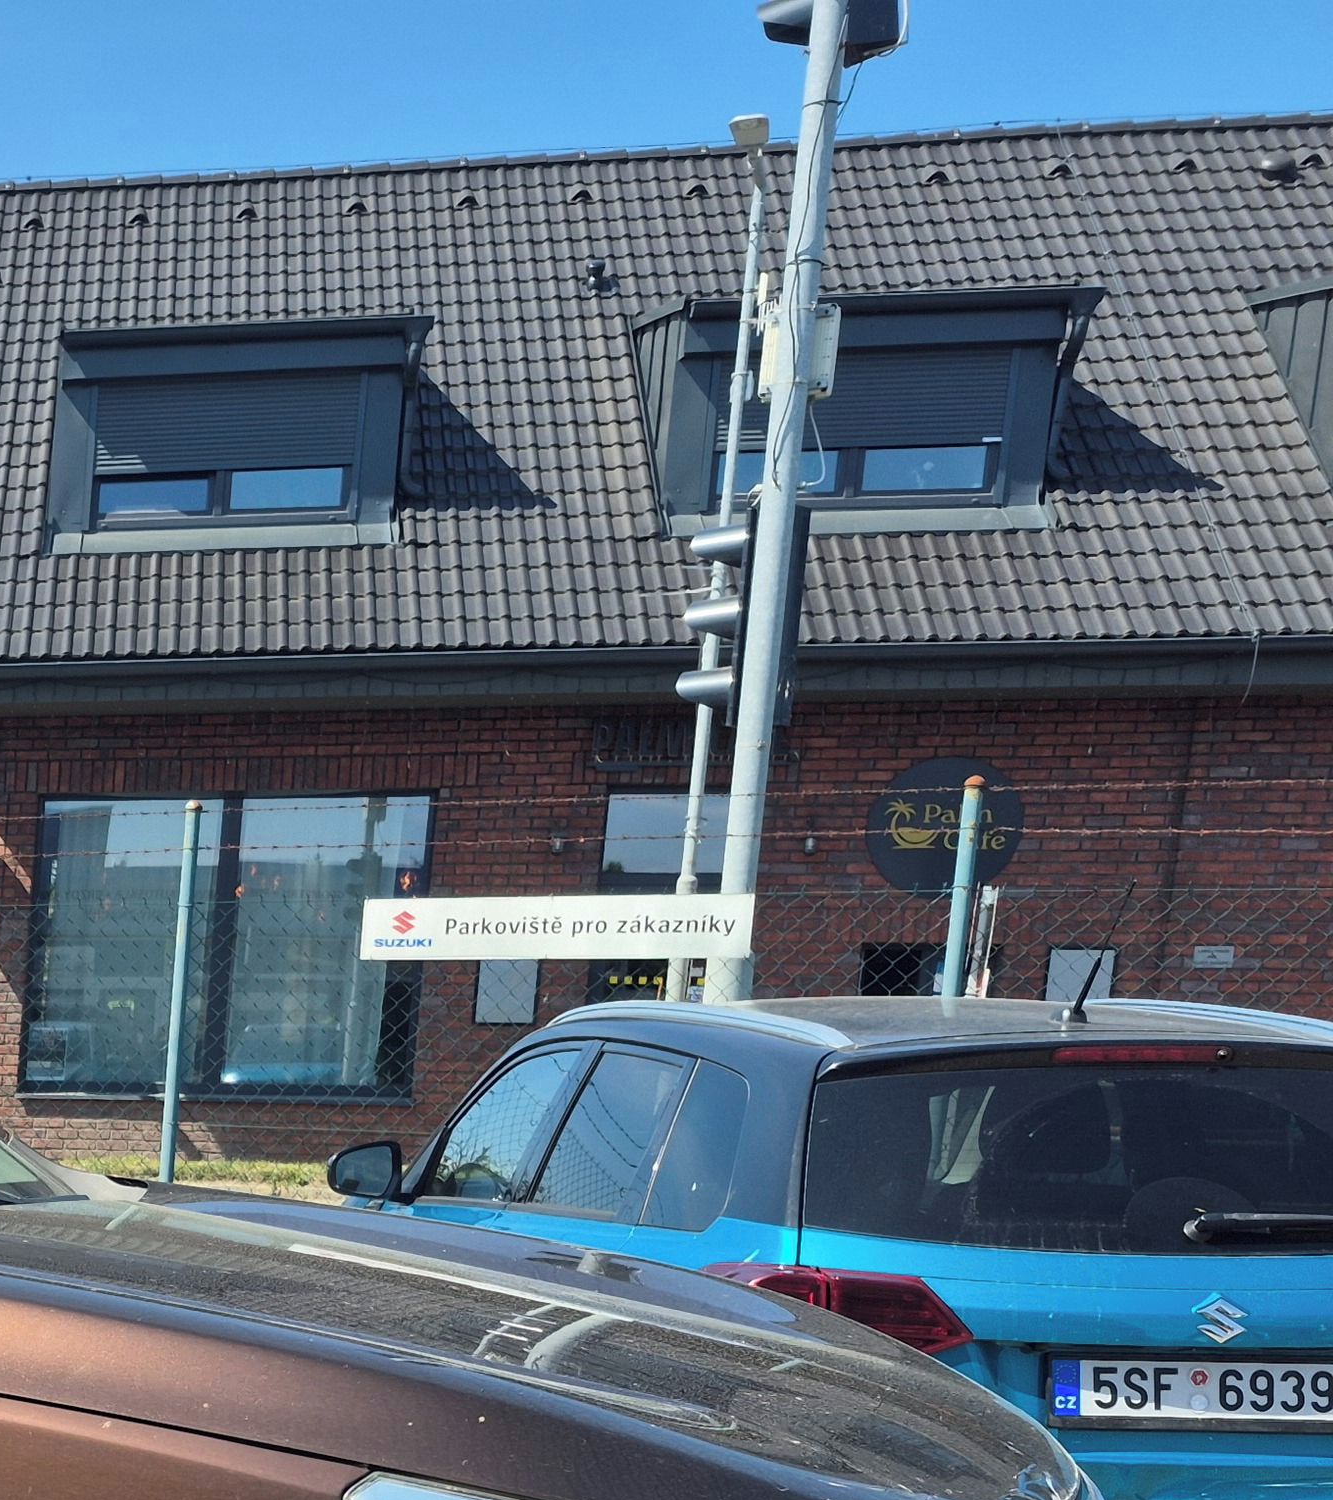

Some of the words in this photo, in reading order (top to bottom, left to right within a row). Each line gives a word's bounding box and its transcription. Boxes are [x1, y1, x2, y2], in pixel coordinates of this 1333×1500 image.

[445, 915, 563, 936] Parkoviště
[571, 919, 608, 938] pro
[616, 914, 736, 937] zákazníky
[373, 938, 432, 948] SUZUKI
[1092, 1366, 1179, 1411] 5SF
[1218, 1369, 1333, 1414] 6939
[1055, 1395, 1077, 1409] CZ
